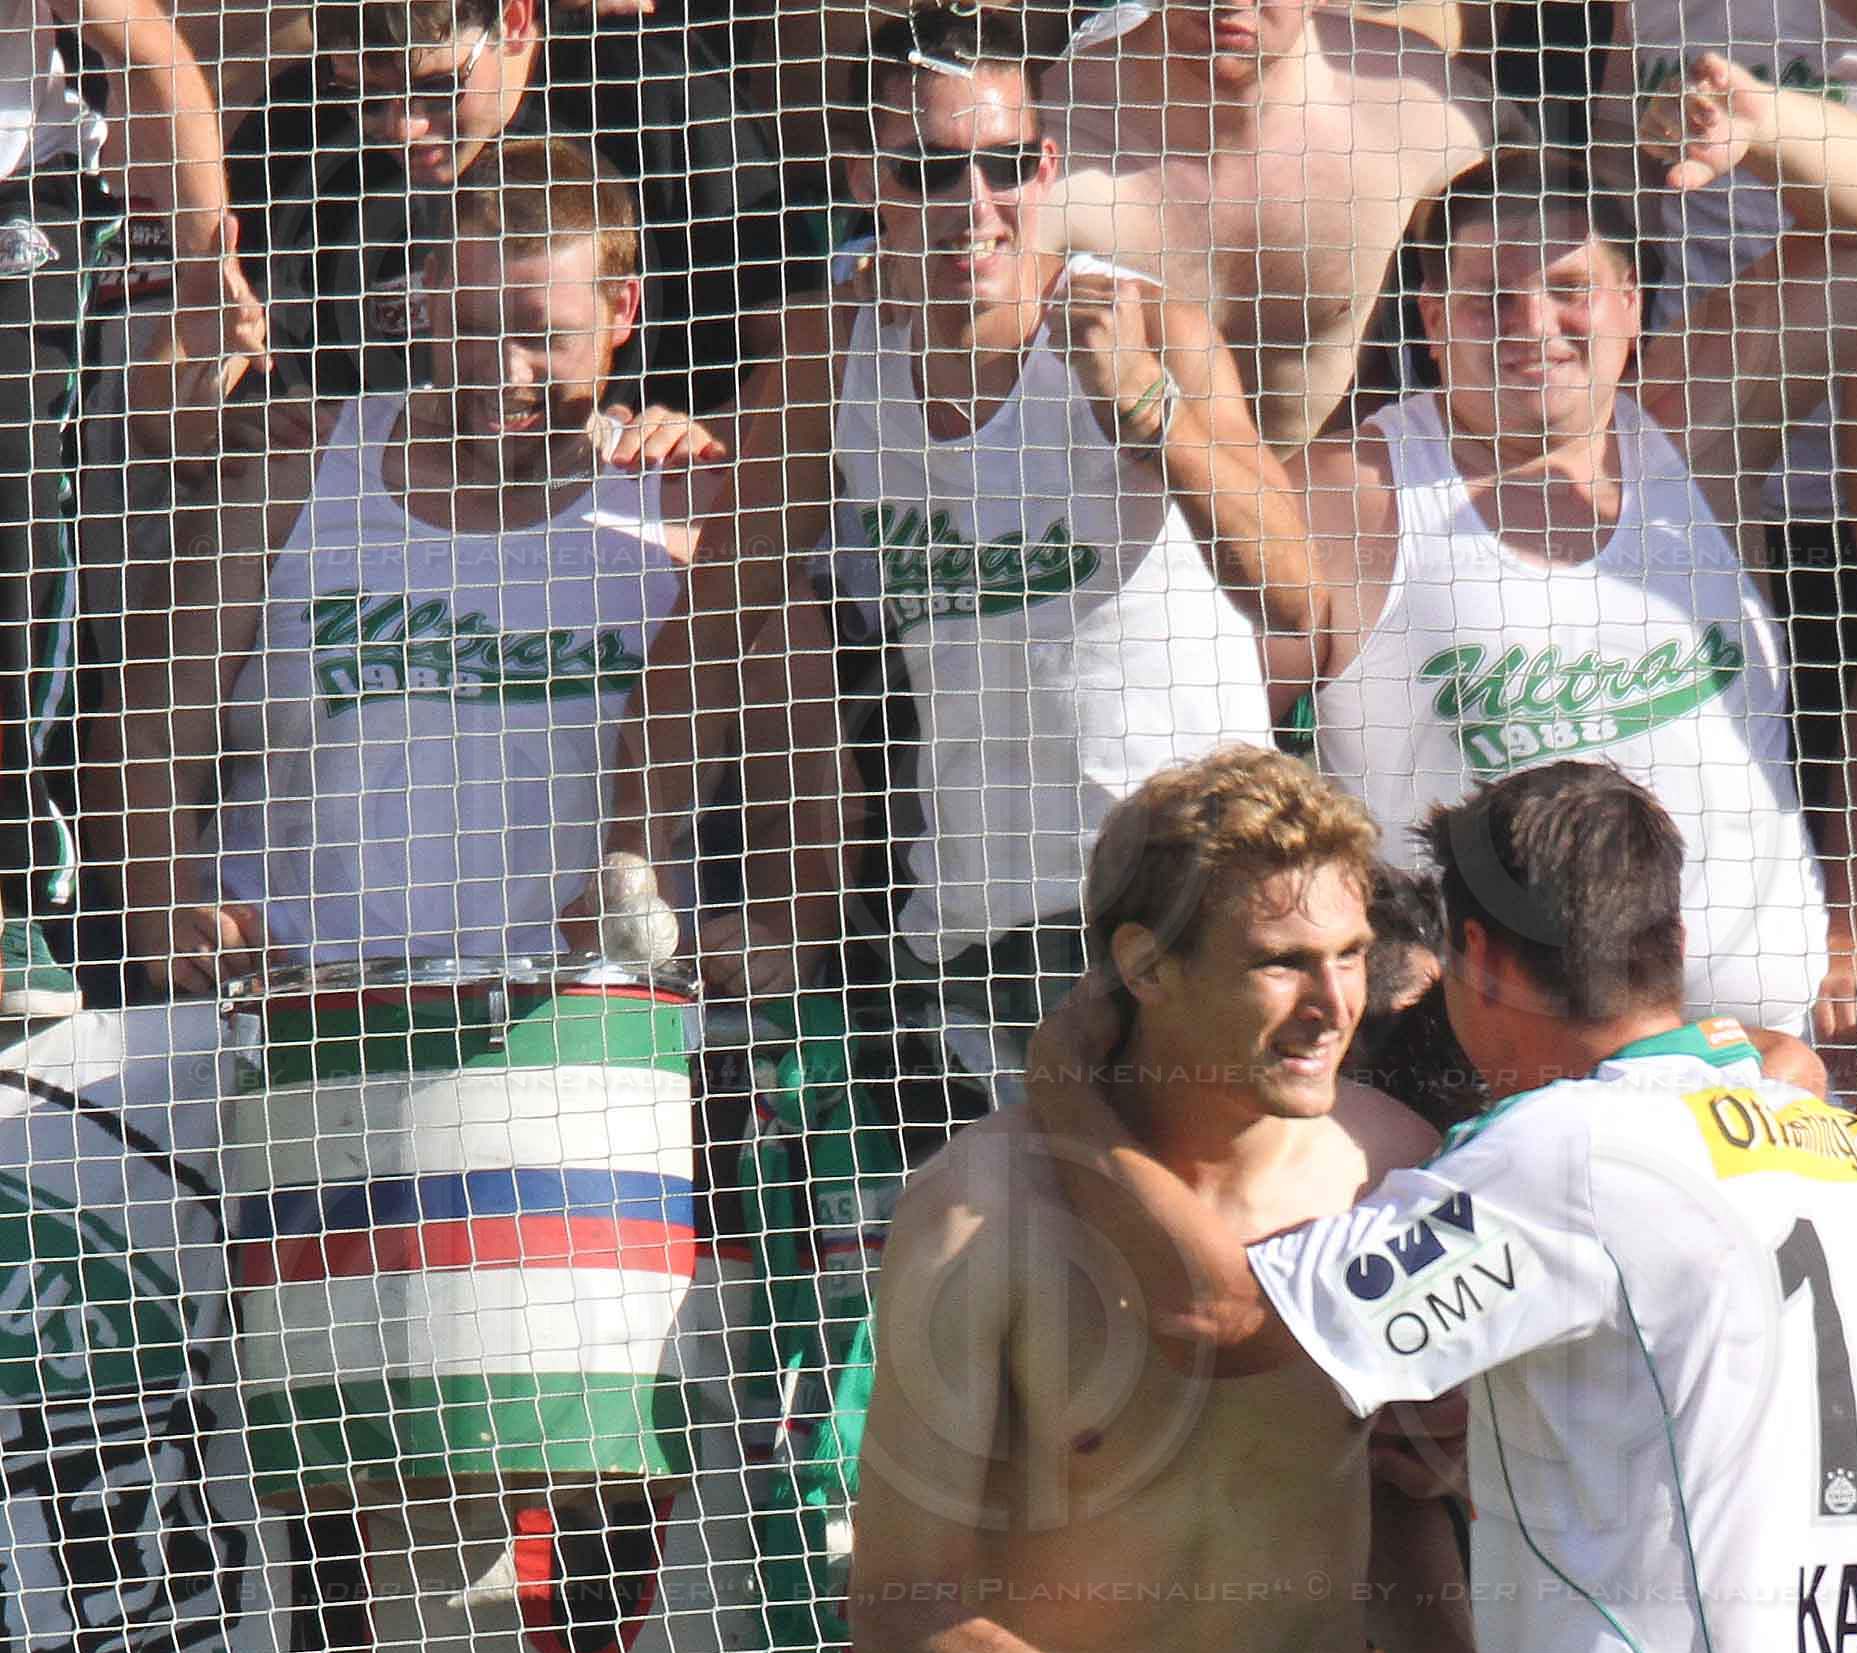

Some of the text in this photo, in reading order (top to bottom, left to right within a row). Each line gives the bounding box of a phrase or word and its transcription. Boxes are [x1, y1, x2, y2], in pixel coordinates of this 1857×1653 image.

[1418, 622, 1744, 718] Ultras
[1471, 718, 1619, 767] 1988
[1386, 1242, 1516, 1356] OMV
